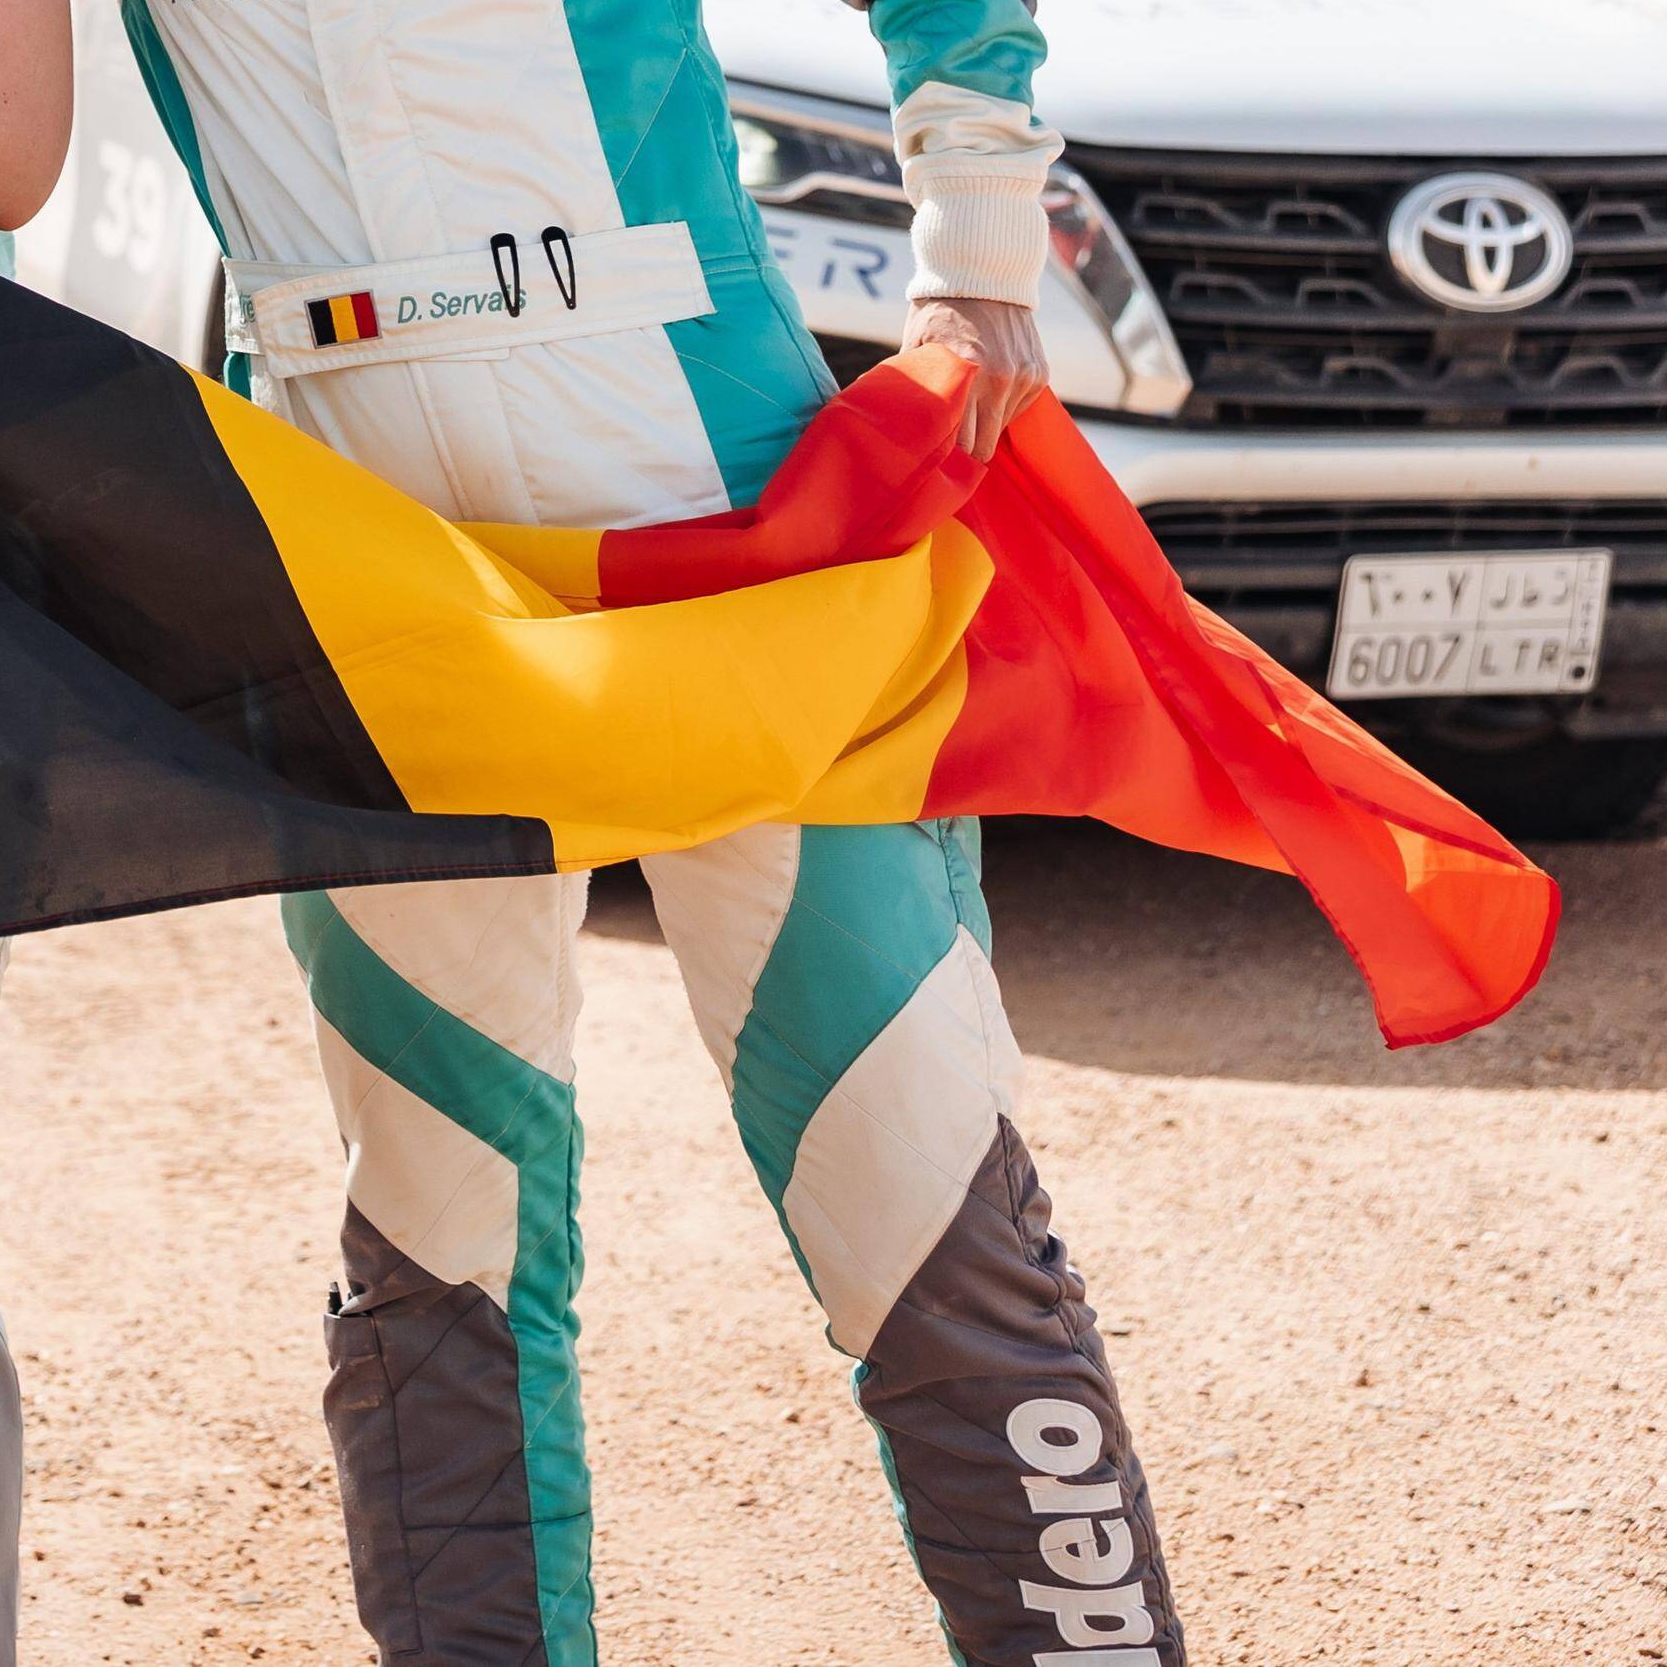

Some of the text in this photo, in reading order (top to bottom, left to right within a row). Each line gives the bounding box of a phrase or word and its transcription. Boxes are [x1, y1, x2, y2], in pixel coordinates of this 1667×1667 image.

[397, 295, 422, 324] D.
[1347, 632, 1463, 688] 6007
[1005, 1397, 1163, 1667] ldero
